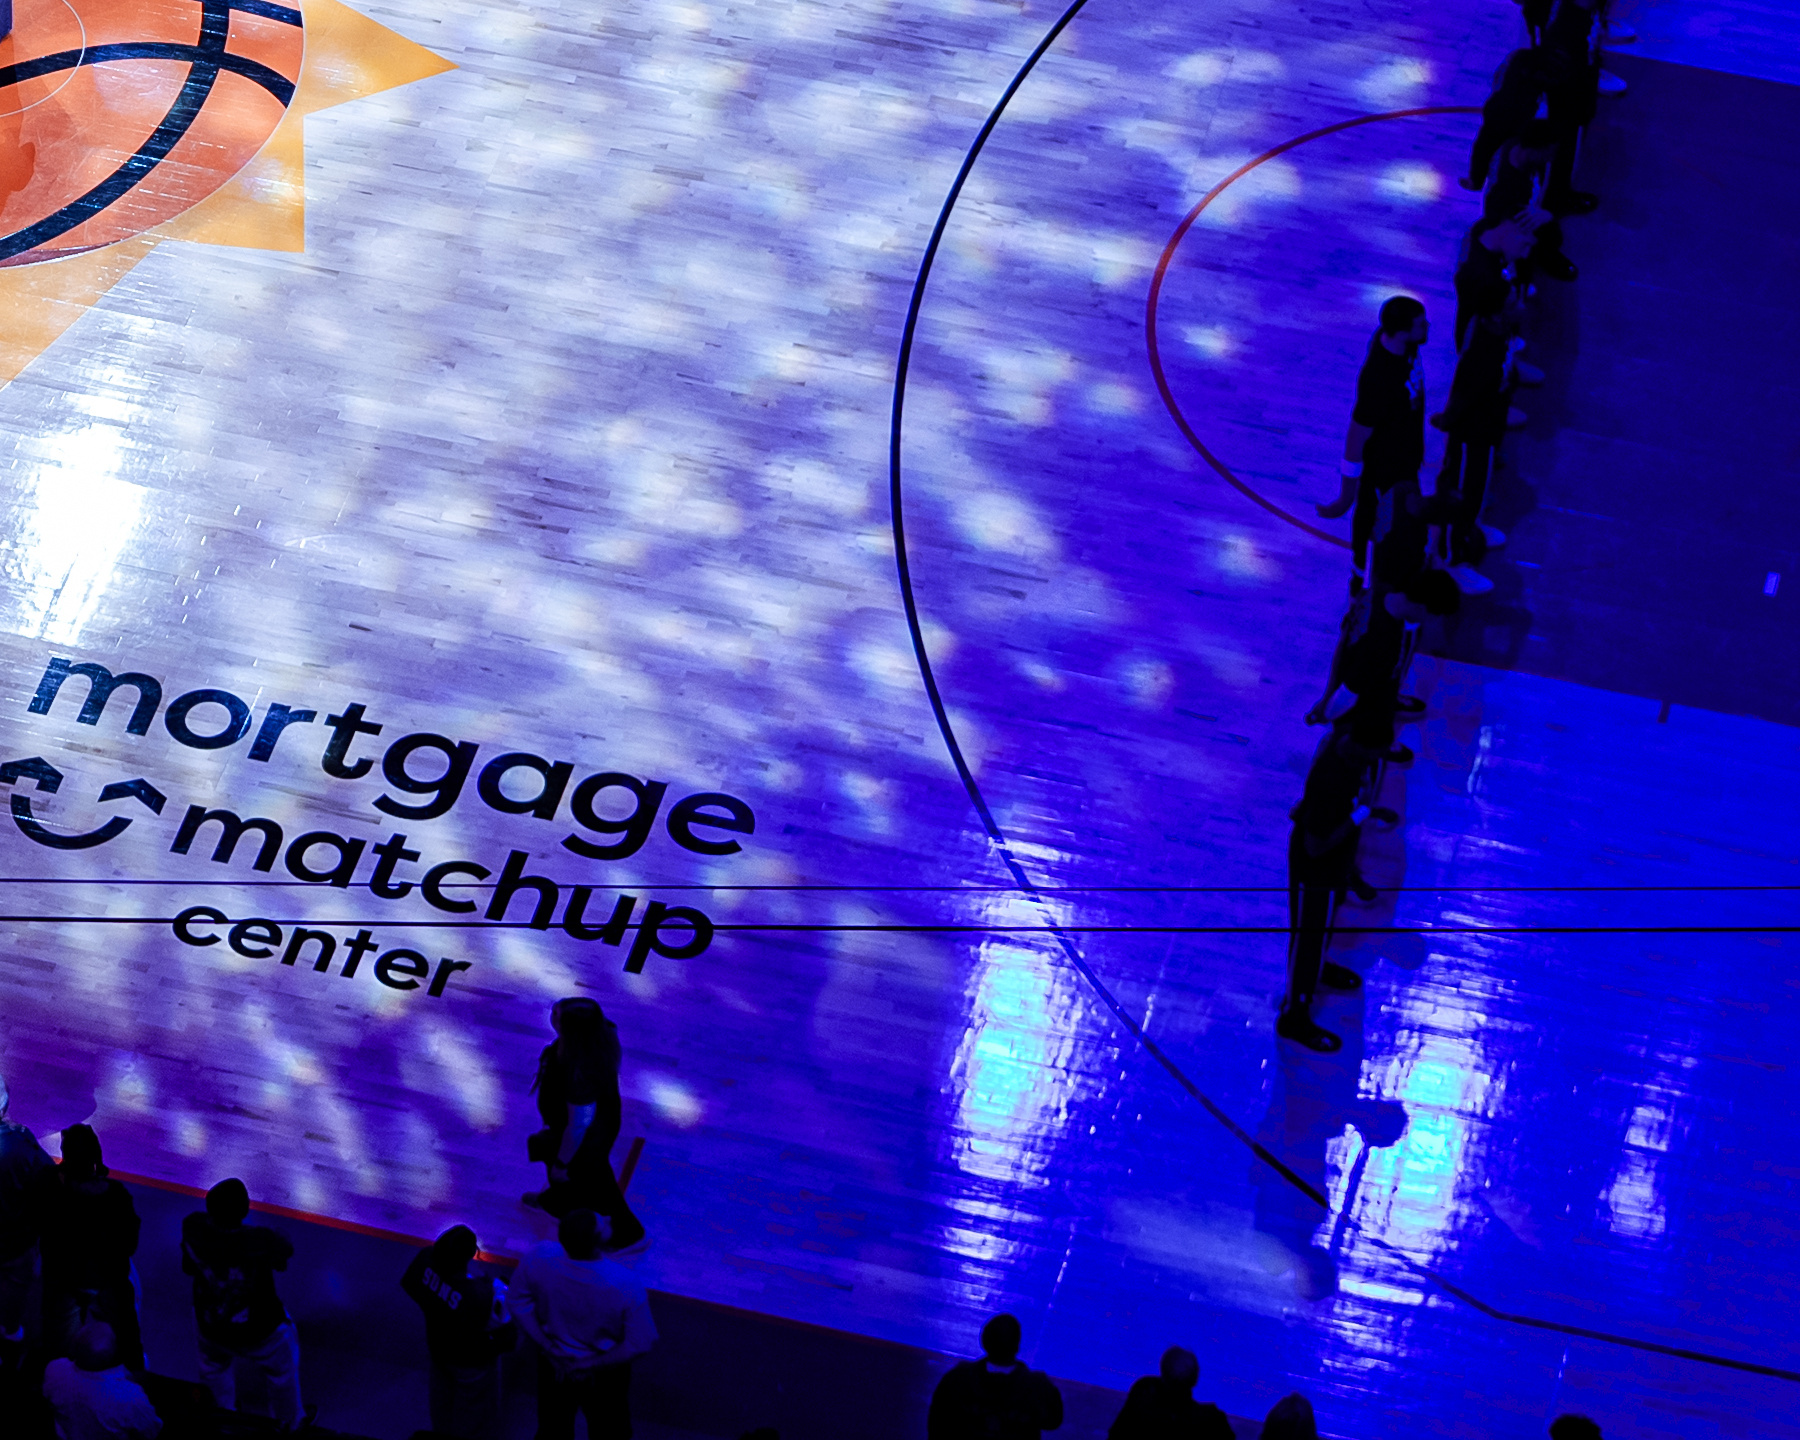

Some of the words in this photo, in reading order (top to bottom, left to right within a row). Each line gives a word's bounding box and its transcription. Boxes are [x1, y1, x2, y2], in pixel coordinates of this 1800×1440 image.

[27, 656, 756, 860] mortgage
[169, 804, 714, 974] matchup
[172, 906, 472, 998] center
